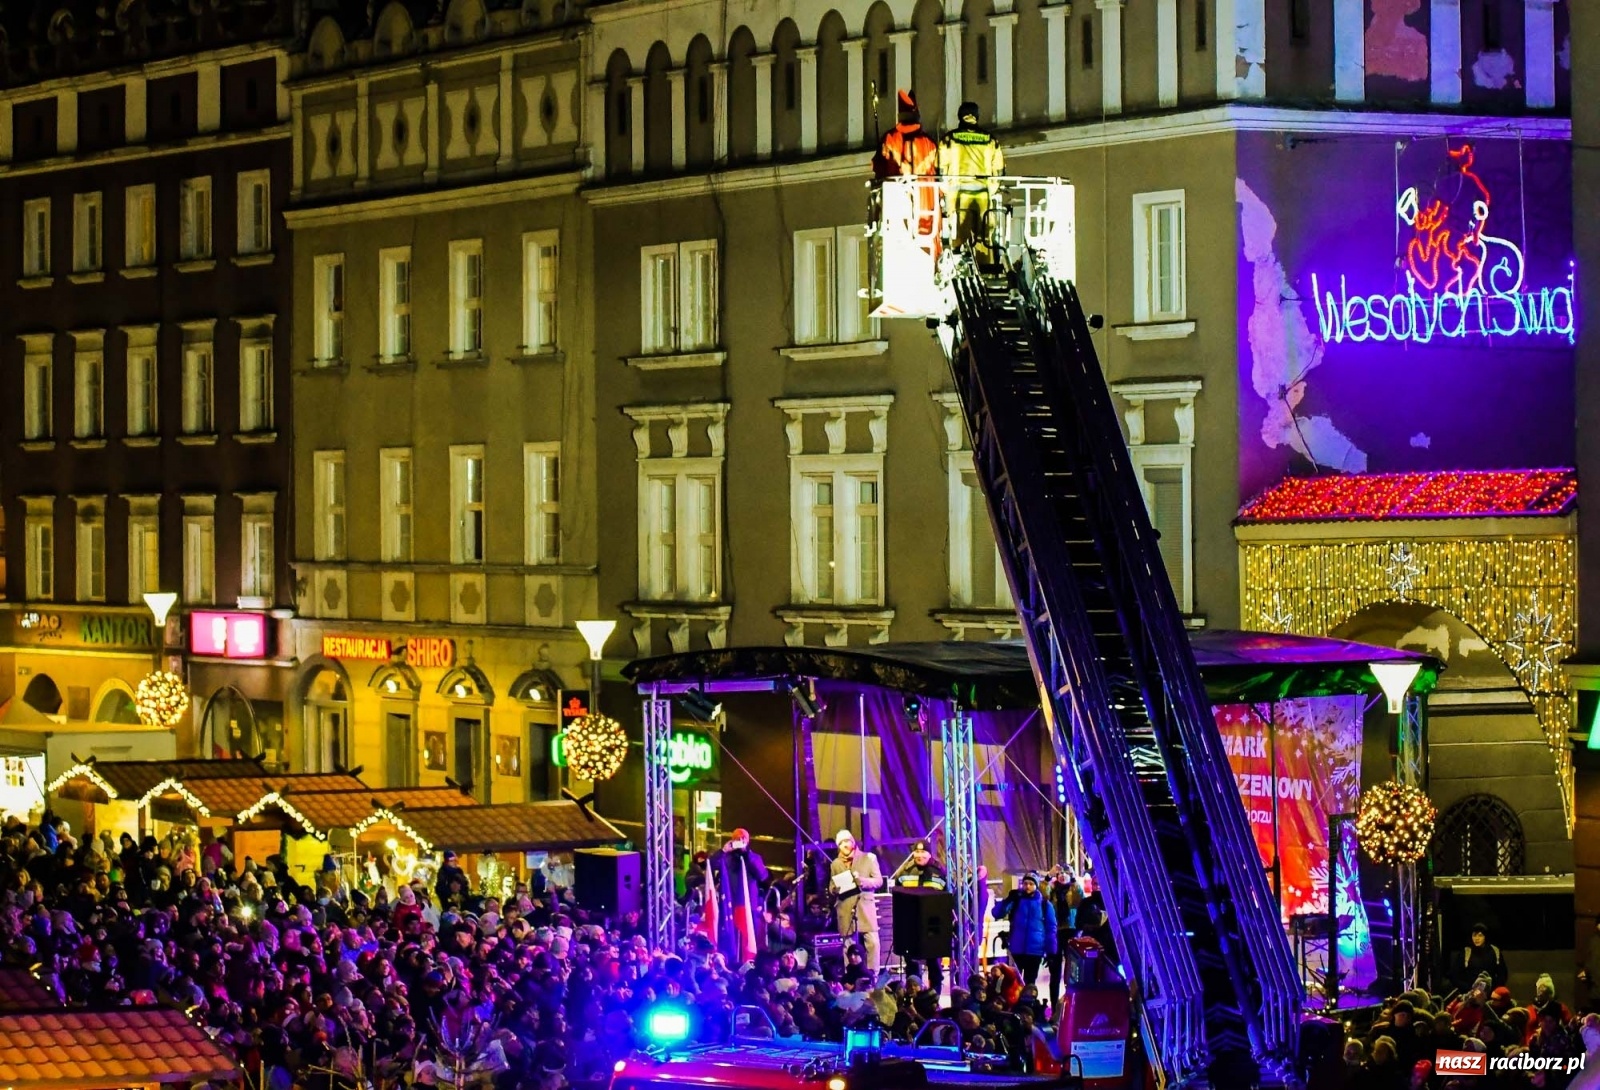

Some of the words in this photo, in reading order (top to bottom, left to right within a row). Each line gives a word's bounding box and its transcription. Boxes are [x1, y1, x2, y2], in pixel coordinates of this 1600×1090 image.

[81, 614, 149, 645] KANTOR
[323, 637, 388, 659] RESTAURACJA
[407, 638, 453, 667] SHIRO
[1233, 773, 1312, 801] ZENIOWY
